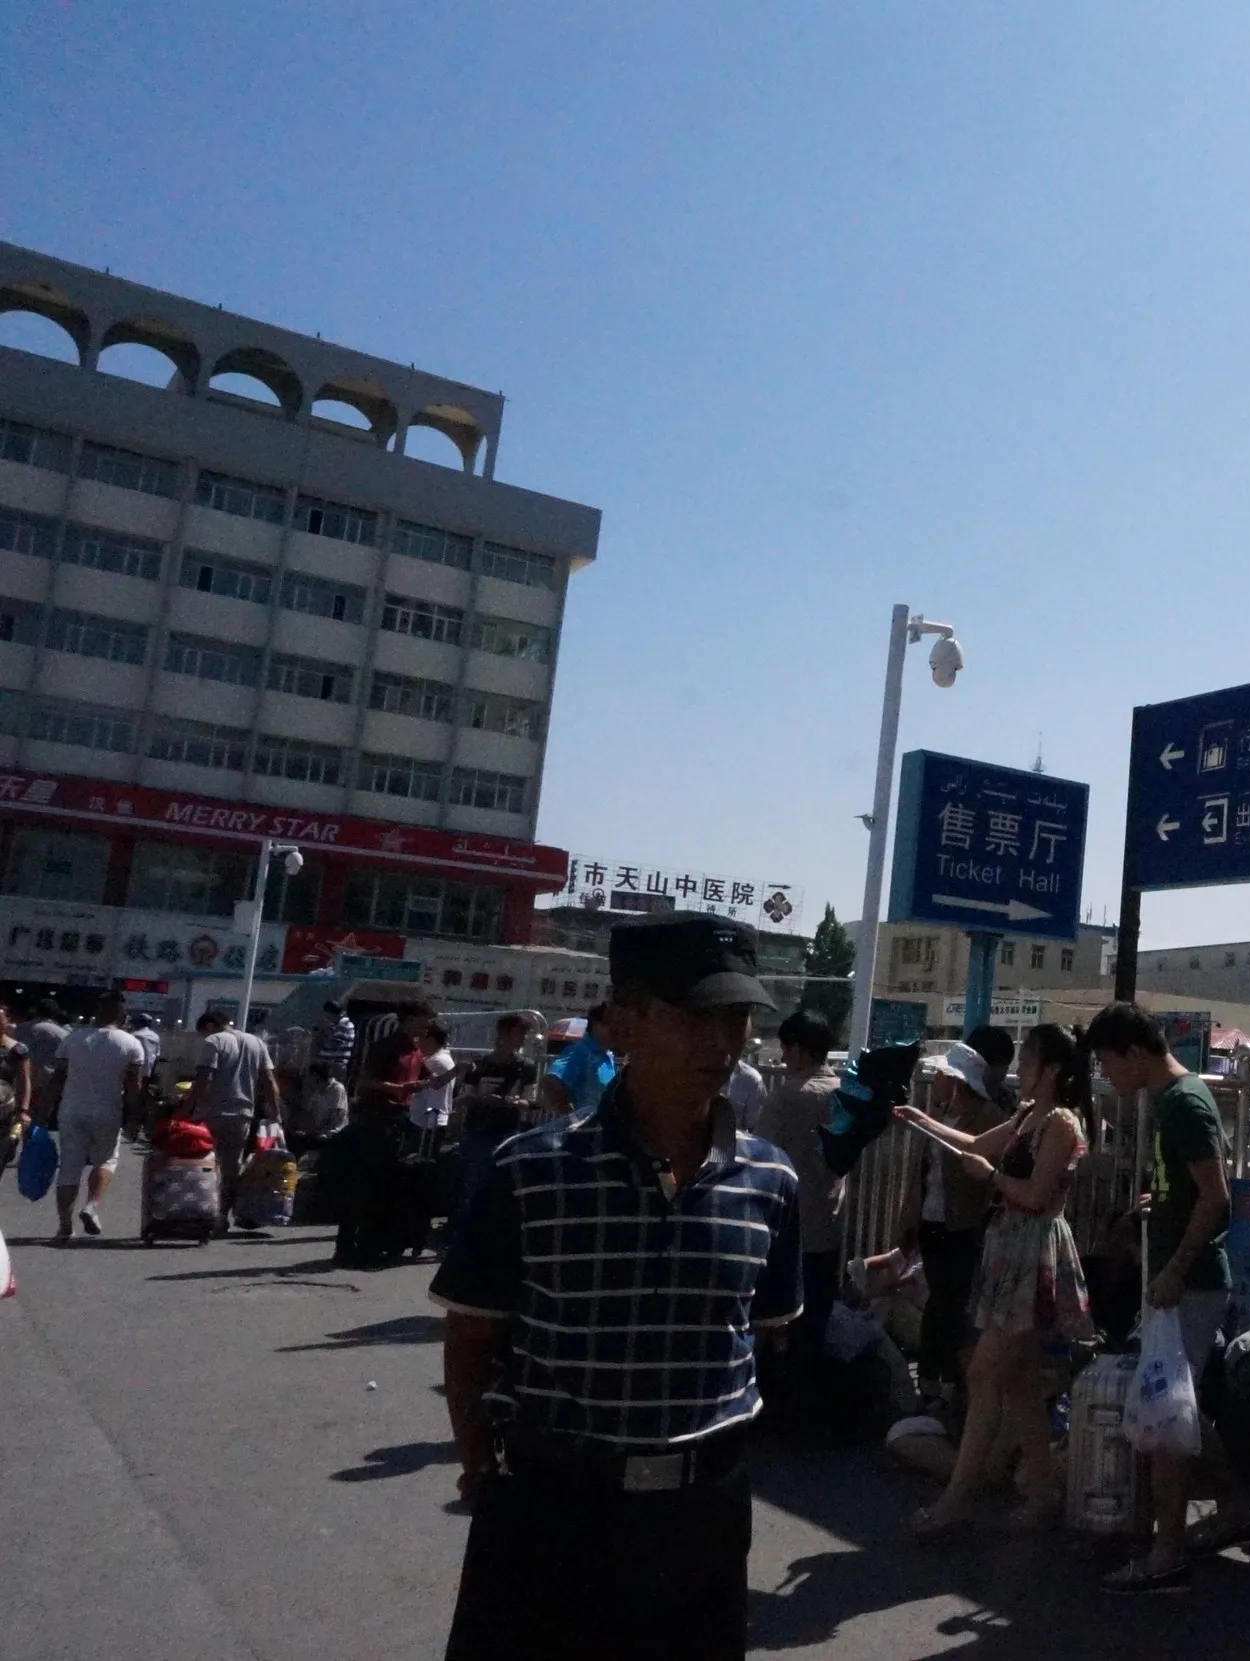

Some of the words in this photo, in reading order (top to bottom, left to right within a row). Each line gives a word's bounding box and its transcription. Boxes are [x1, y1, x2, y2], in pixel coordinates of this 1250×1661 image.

[164, 800, 267, 833] MERRY
[267, 815, 341, 843] STAR
[937, 800, 1069, 865] 售票厅
[583, 861, 755, 907] 市天山中医院
[936, 852, 1003, 886] Ticket
[1018, 867, 1062, 895] Hall
